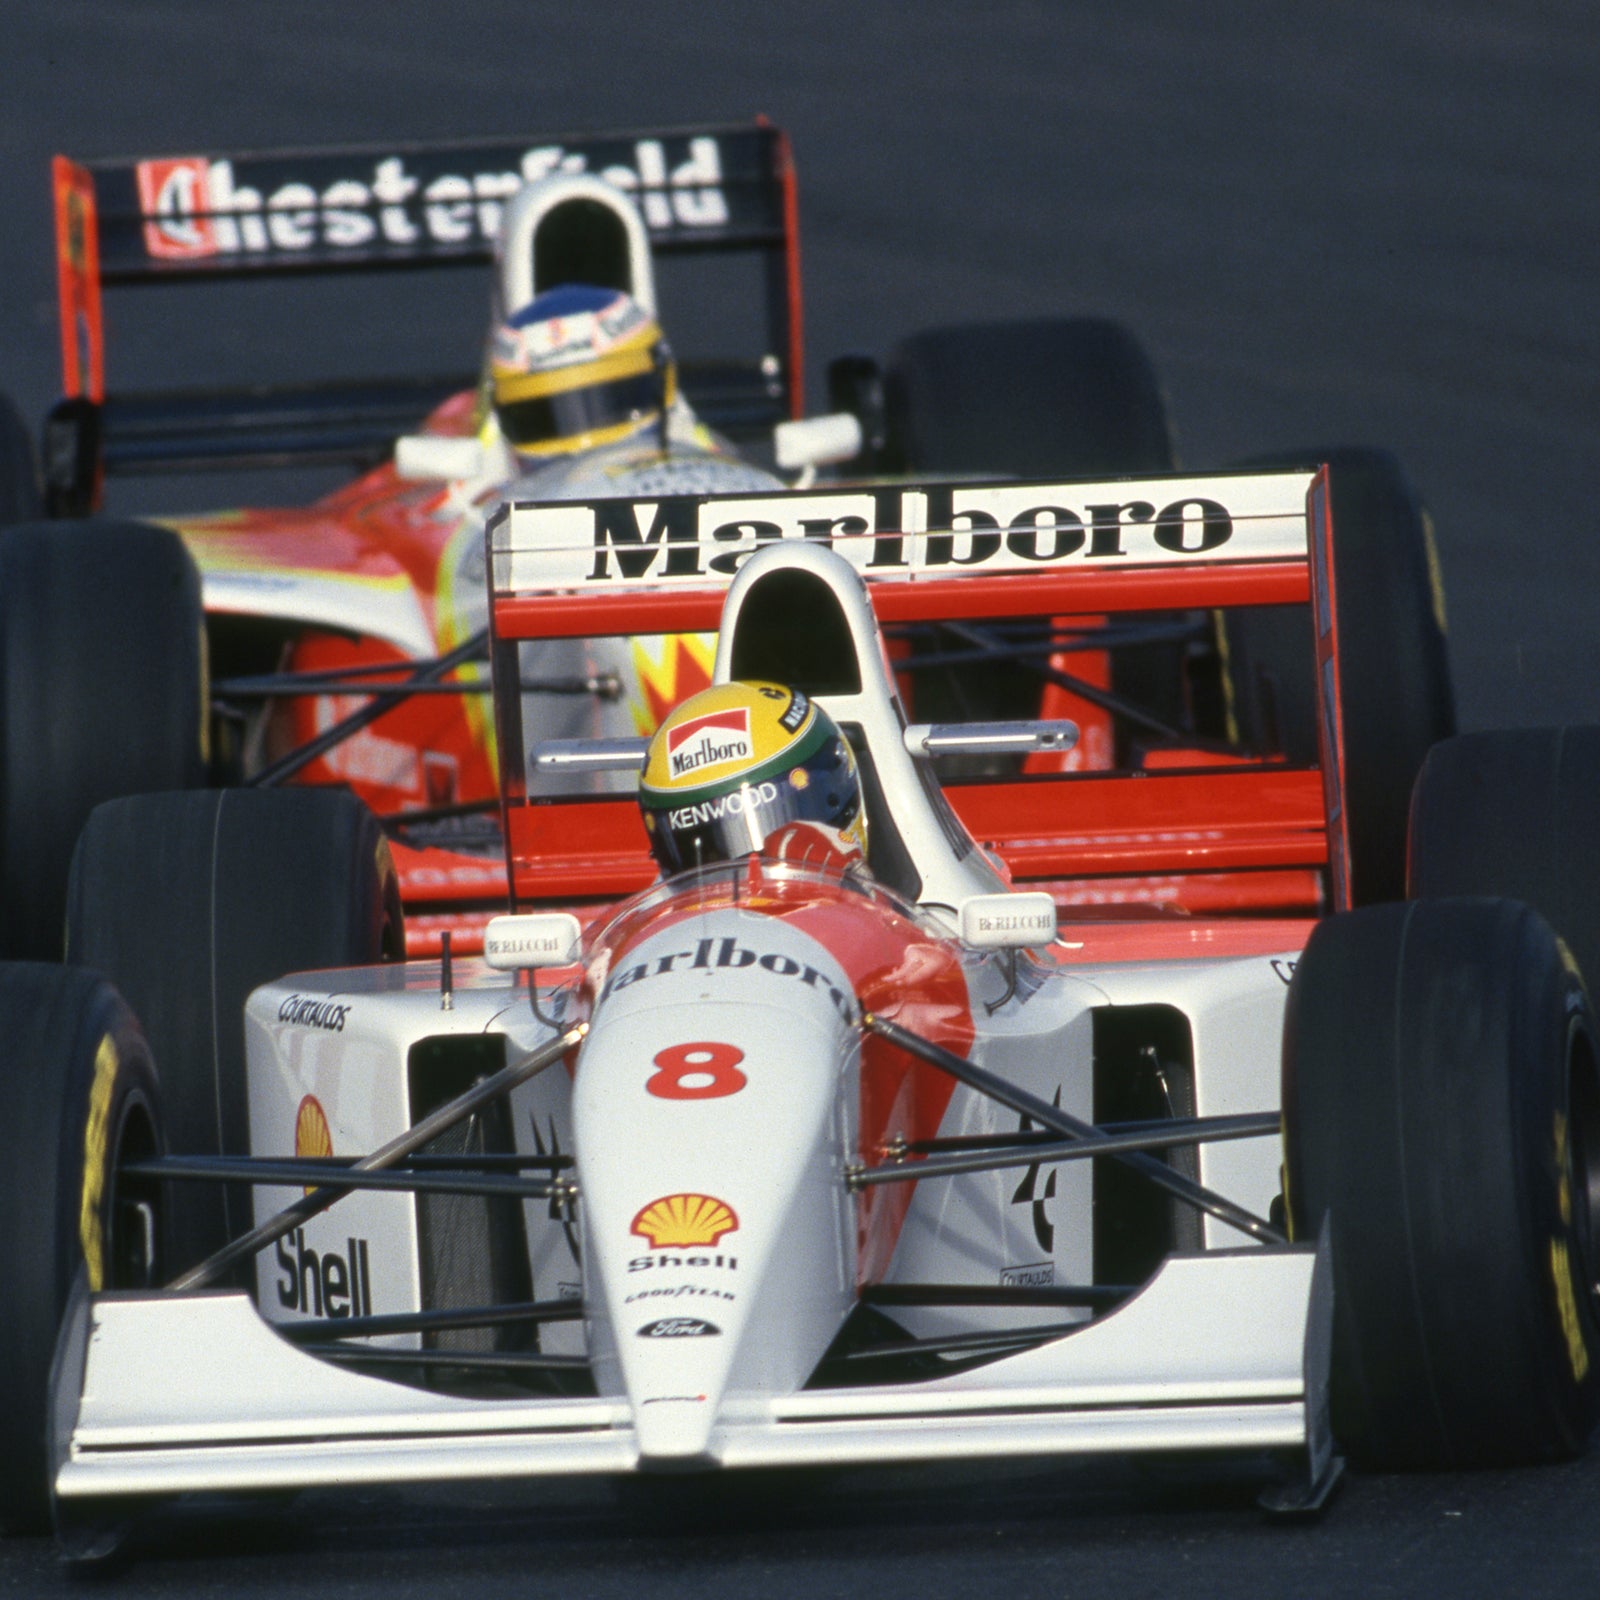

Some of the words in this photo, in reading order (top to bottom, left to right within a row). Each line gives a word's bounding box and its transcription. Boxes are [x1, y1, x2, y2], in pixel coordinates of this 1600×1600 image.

[156, 137, 729, 251] Chesterld
[585, 490, 1233, 580] Marlboro
[672, 738, 748, 777] Marlboro
[668, 782, 777, 830] KENWOOD
[646, 1042, 747, 1100] 8
[276, 1227, 373, 1319] Shell
[627, 1255, 738, 1273] Shell
[650, 1319, 707, 1337] Ford
